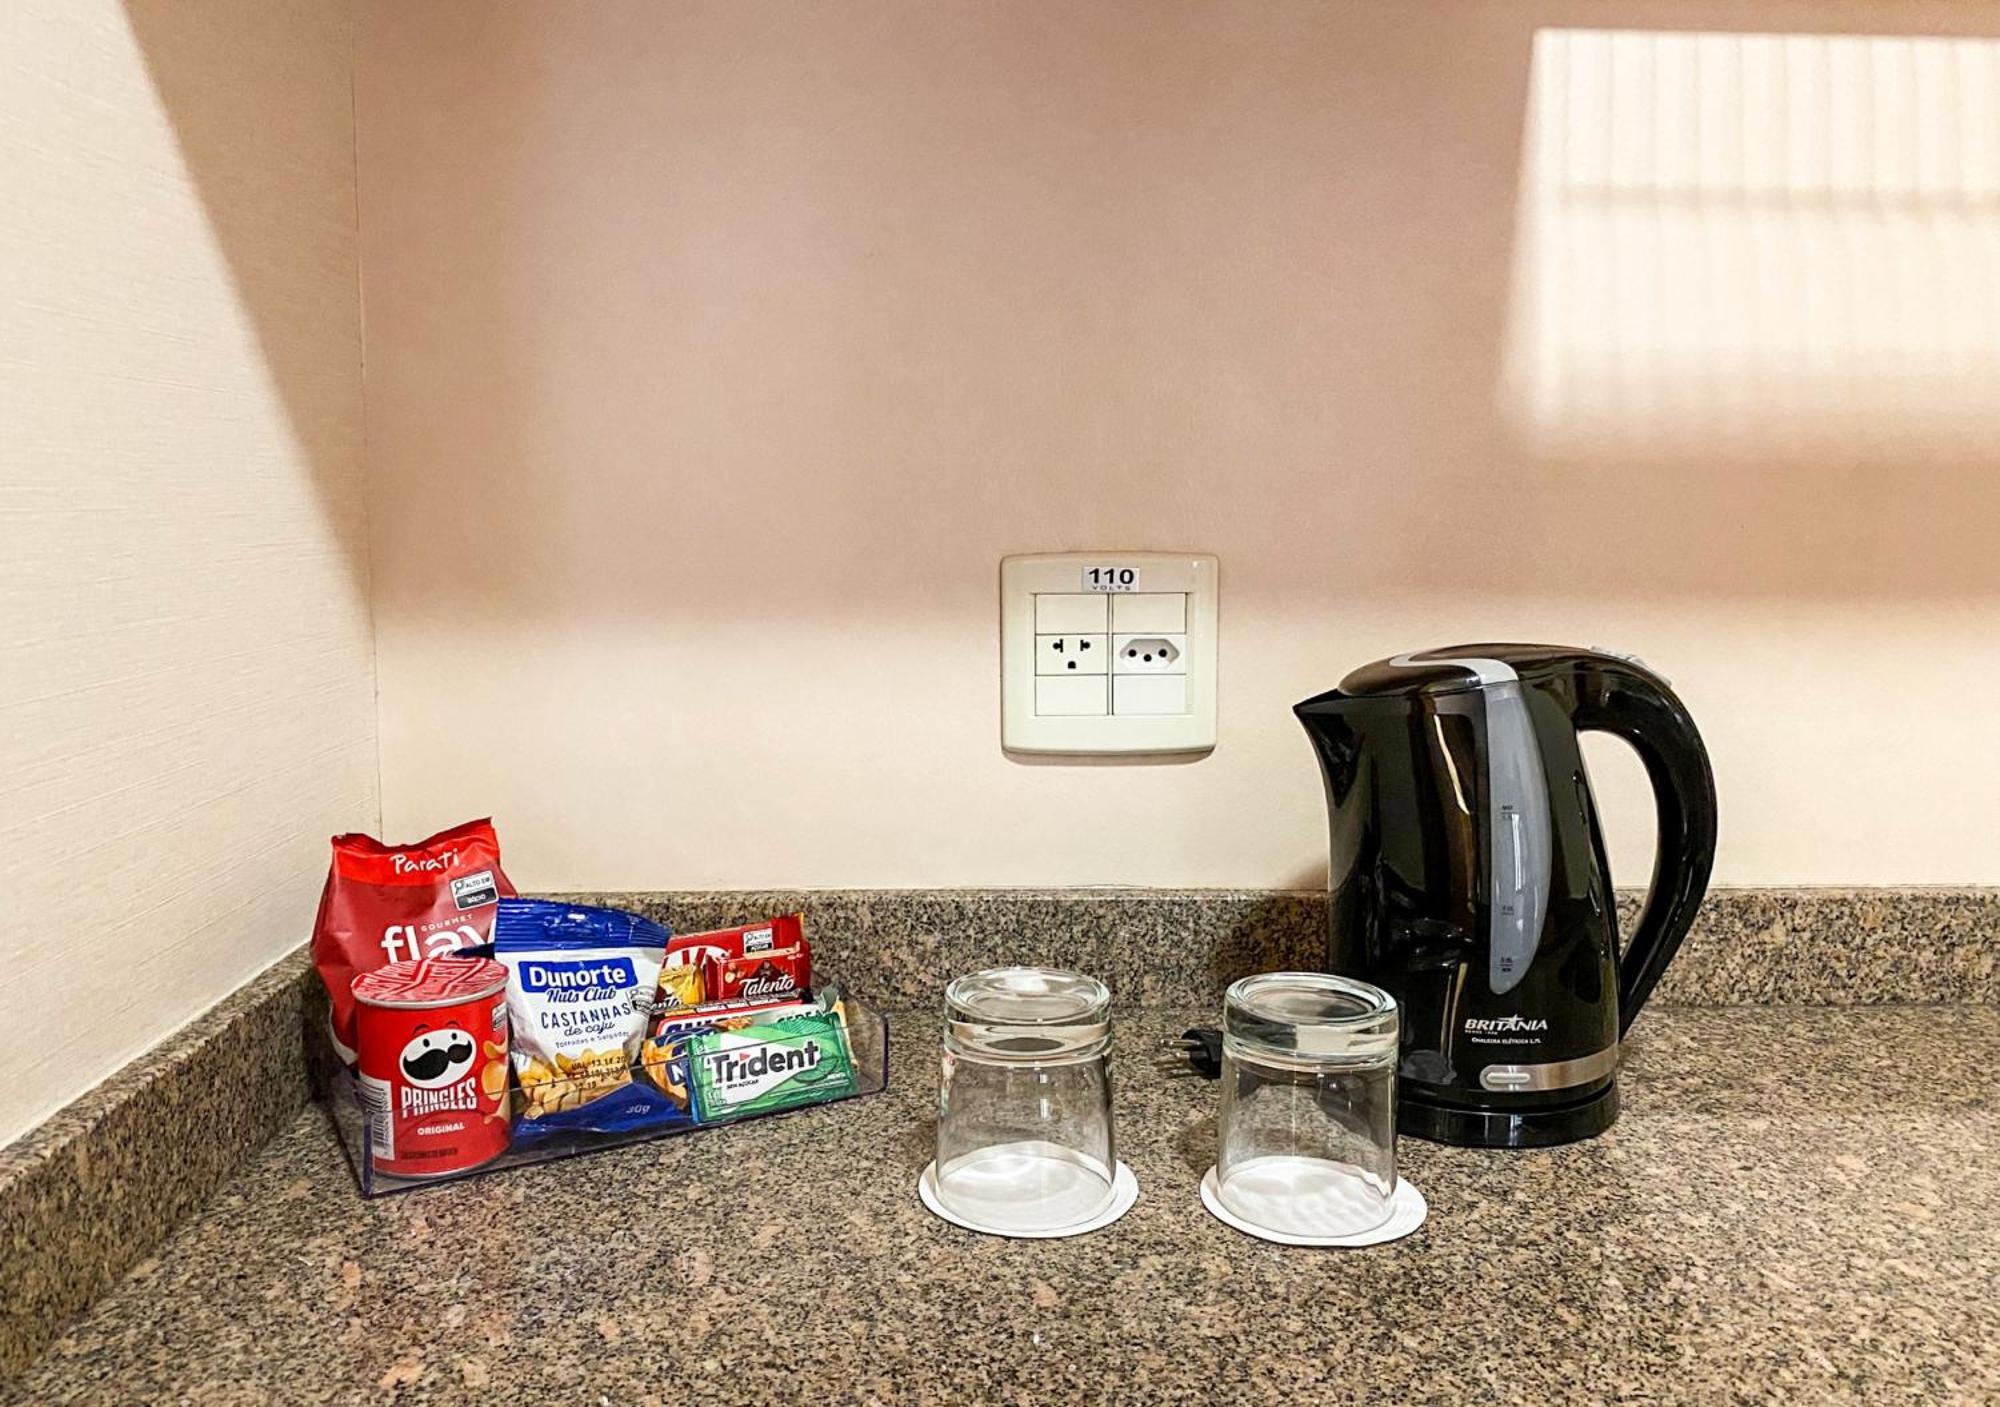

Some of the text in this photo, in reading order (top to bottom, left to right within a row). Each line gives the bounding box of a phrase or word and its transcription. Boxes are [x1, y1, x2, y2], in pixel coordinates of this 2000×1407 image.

[1088, 567, 1135, 585] 110
[389, 847, 460, 875] Parati
[420, 913, 474, 932] GOURMET
[528, 964, 627, 988] Dunorte
[739, 974, 795, 1000] Talento
[546, 988, 580, 1003] Nuts
[582, 986, 617, 1002] Club
[540, 1002, 632, 1029] CASTANHAS
[564, 1020, 616, 1037] de caju
[711, 1040, 820, 1085] Trident
[400, 1077, 478, 1119] PRINGLES
[416, 1122, 466, 1136] ORIGINAL
